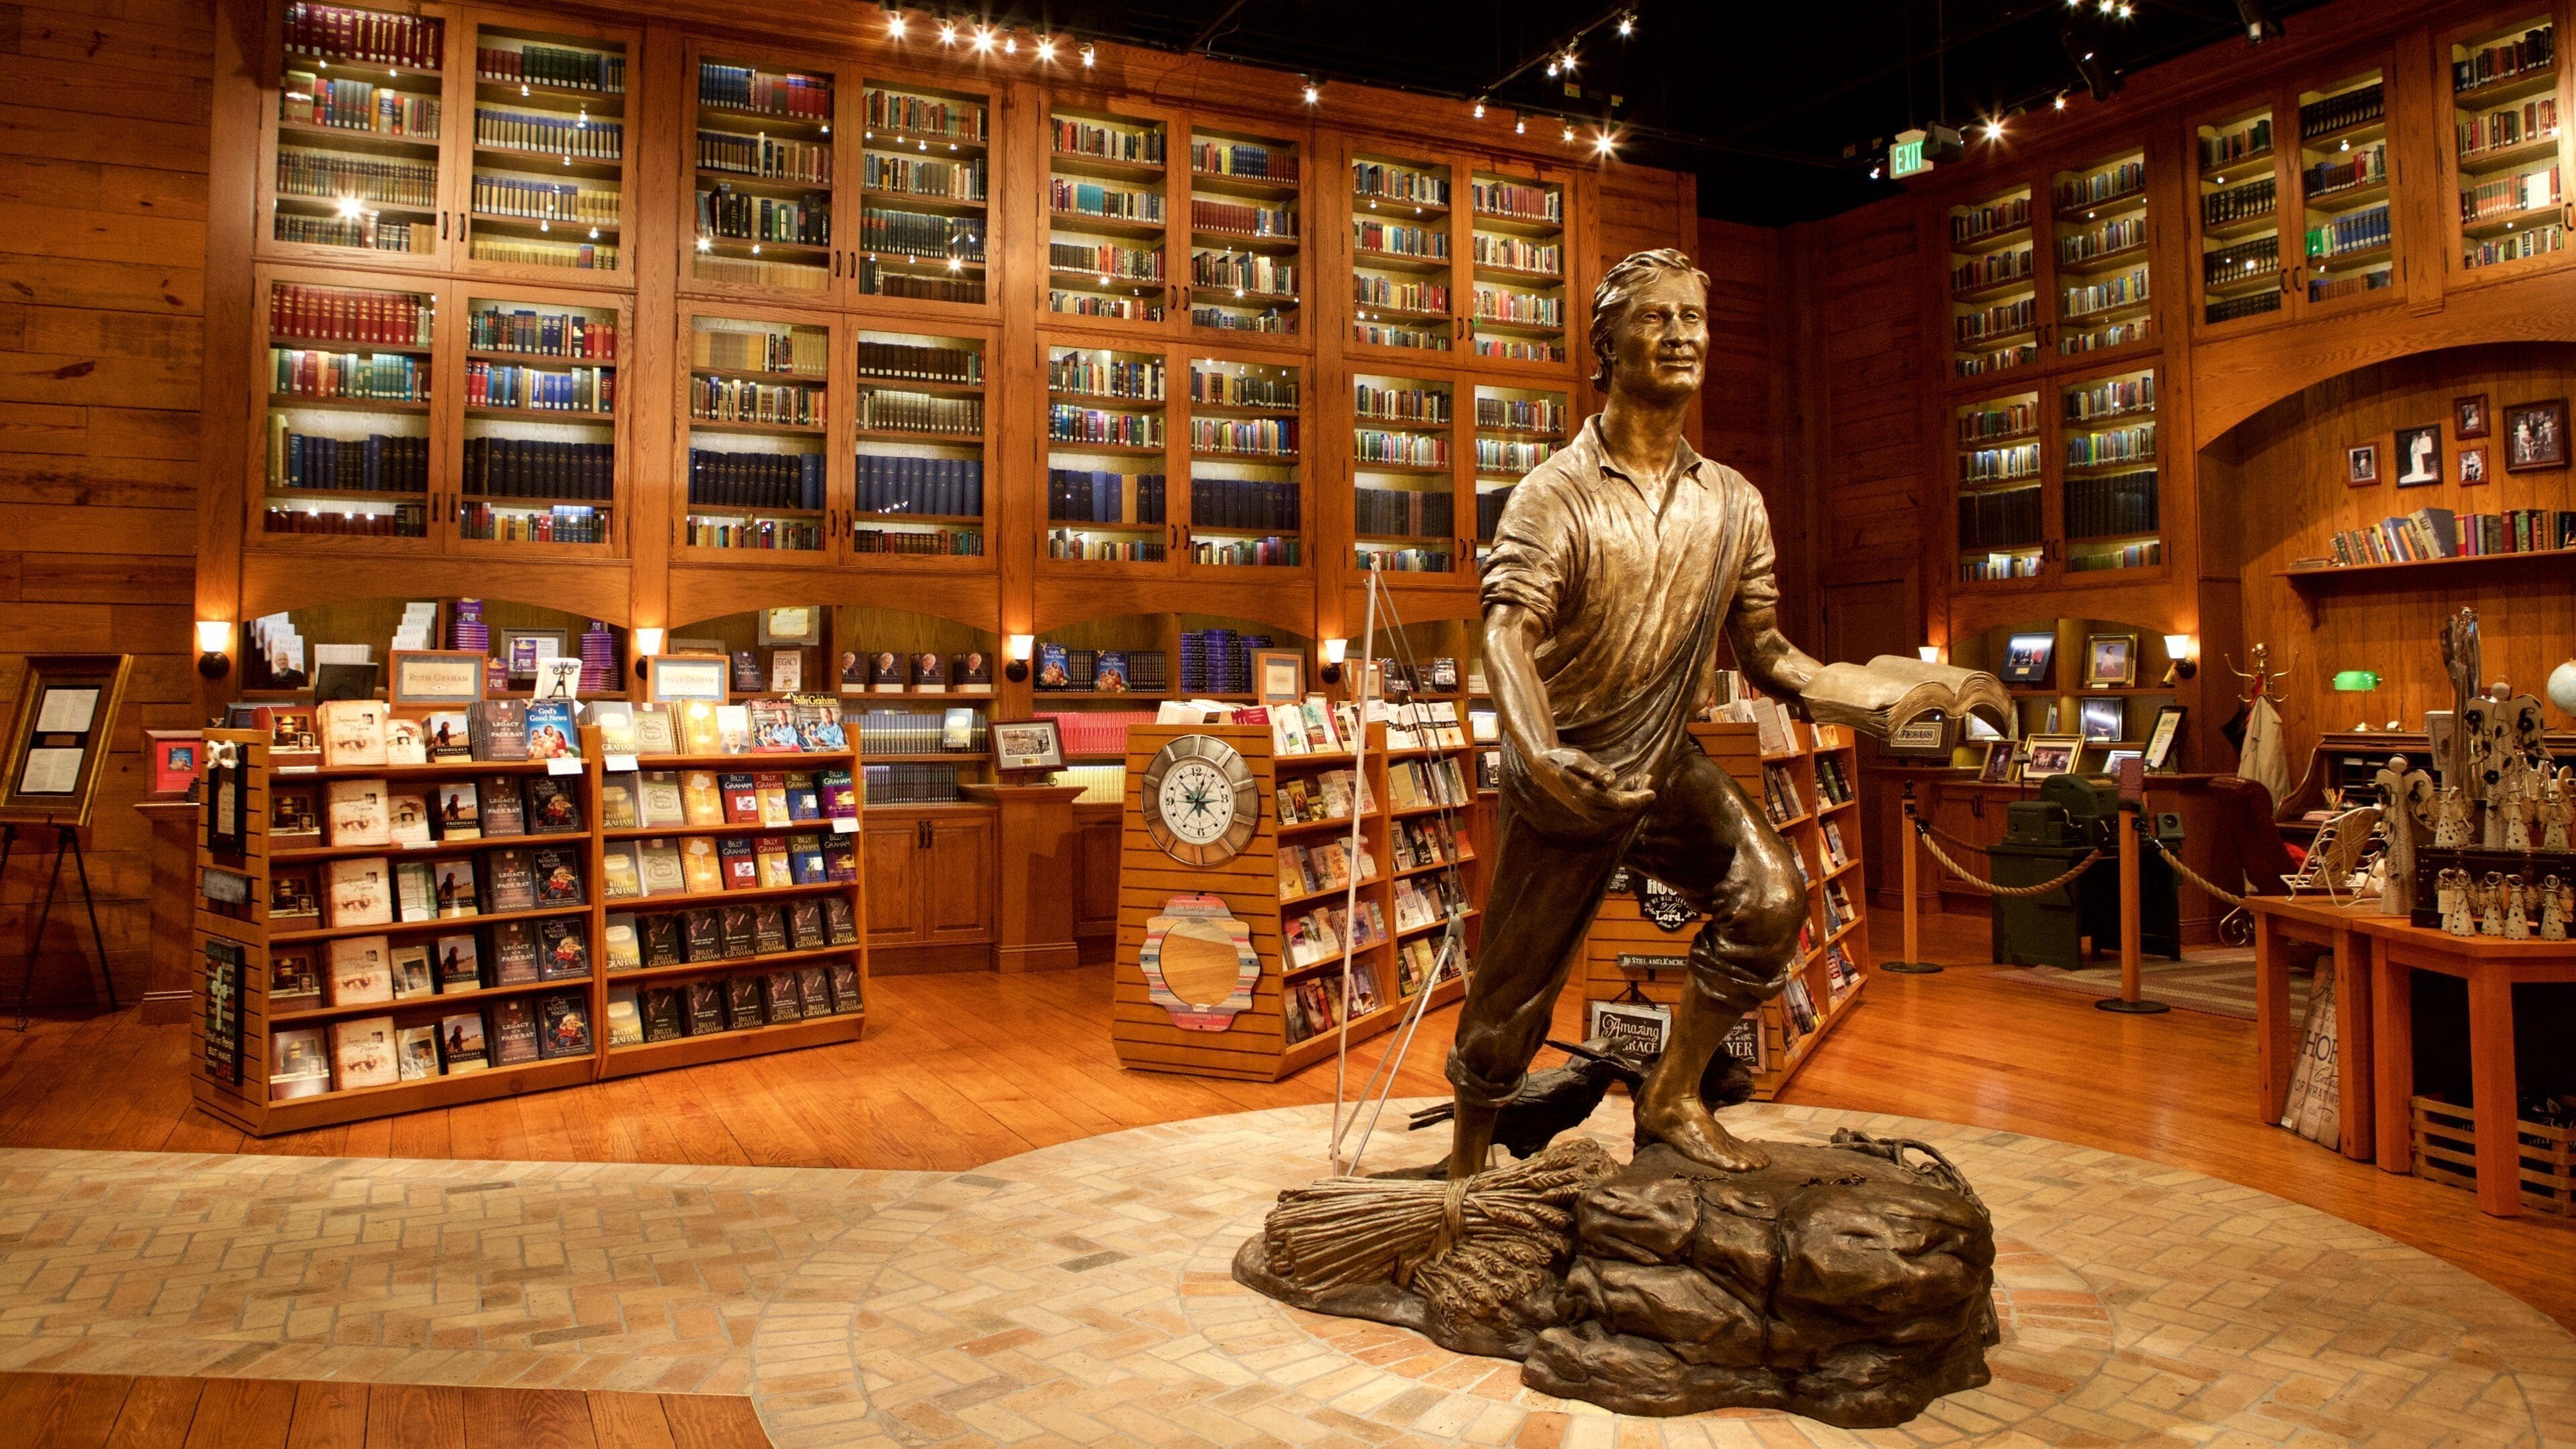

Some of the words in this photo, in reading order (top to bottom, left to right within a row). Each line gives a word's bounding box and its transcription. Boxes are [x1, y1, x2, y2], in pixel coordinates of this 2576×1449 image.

[1895, 141, 1923, 174] EXIT
[775, 657, 798, 669] LEGACY
[409, 674, 431, 682] RUTH
[433, 674, 469, 682] GRAHAM
[751, 700, 765, 709] Billy
[794, 695, 809, 706] Billy
[809, 696, 837, 705] Graham
[549, 714, 568, 722] News
[1899, 729, 1933, 739] JESUS
[602, 743, 637, 751] GRAHAM
[1191, 767, 1202, 776] 12
[724, 782, 753, 790] GRAHAM
[823, 777, 851, 786] GRAHAM
[1167, 796, 1174, 806] 9
[603, 818, 634, 827] GRAHAM
[1197, 828, 1205, 837] 6
[824, 841, 851, 849] GRAHAM
[604, 885, 637, 896] GRAHAM
[1656, 910, 1684, 922] Lord.
[796, 940, 824, 949] GRAHAM
[832, 936, 858, 944] GRAHAM
[724, 949, 755, 958] GRAHAM
[757, 945, 786, 953] GRAHAM
[610, 952, 629, 960] BILLY
[690, 953, 720, 962] GRAHAM
[606, 957, 639, 968] GRAHAM
[804, 1008, 831, 1017] GRAHAM
[836, 1004, 863, 1012] GRAHAM
[772, 1012, 801, 1022] GRAHAM
[733, 1020, 763, 1028] GRAHAM
[1601, 1013, 1660, 1042] Amazing
[613, 1028, 633, 1036] BILLY
[693, 1026, 724, 1034] GRAHAM
[608, 1033, 641, 1044] GRAHAM
[648, 1032, 680, 1042] GRAHAM
[1734, 1032, 1756, 1042] with
[449, 1051, 481, 1059] PRODIGALS
[2306, 1084, 2328, 1102] WHAT
